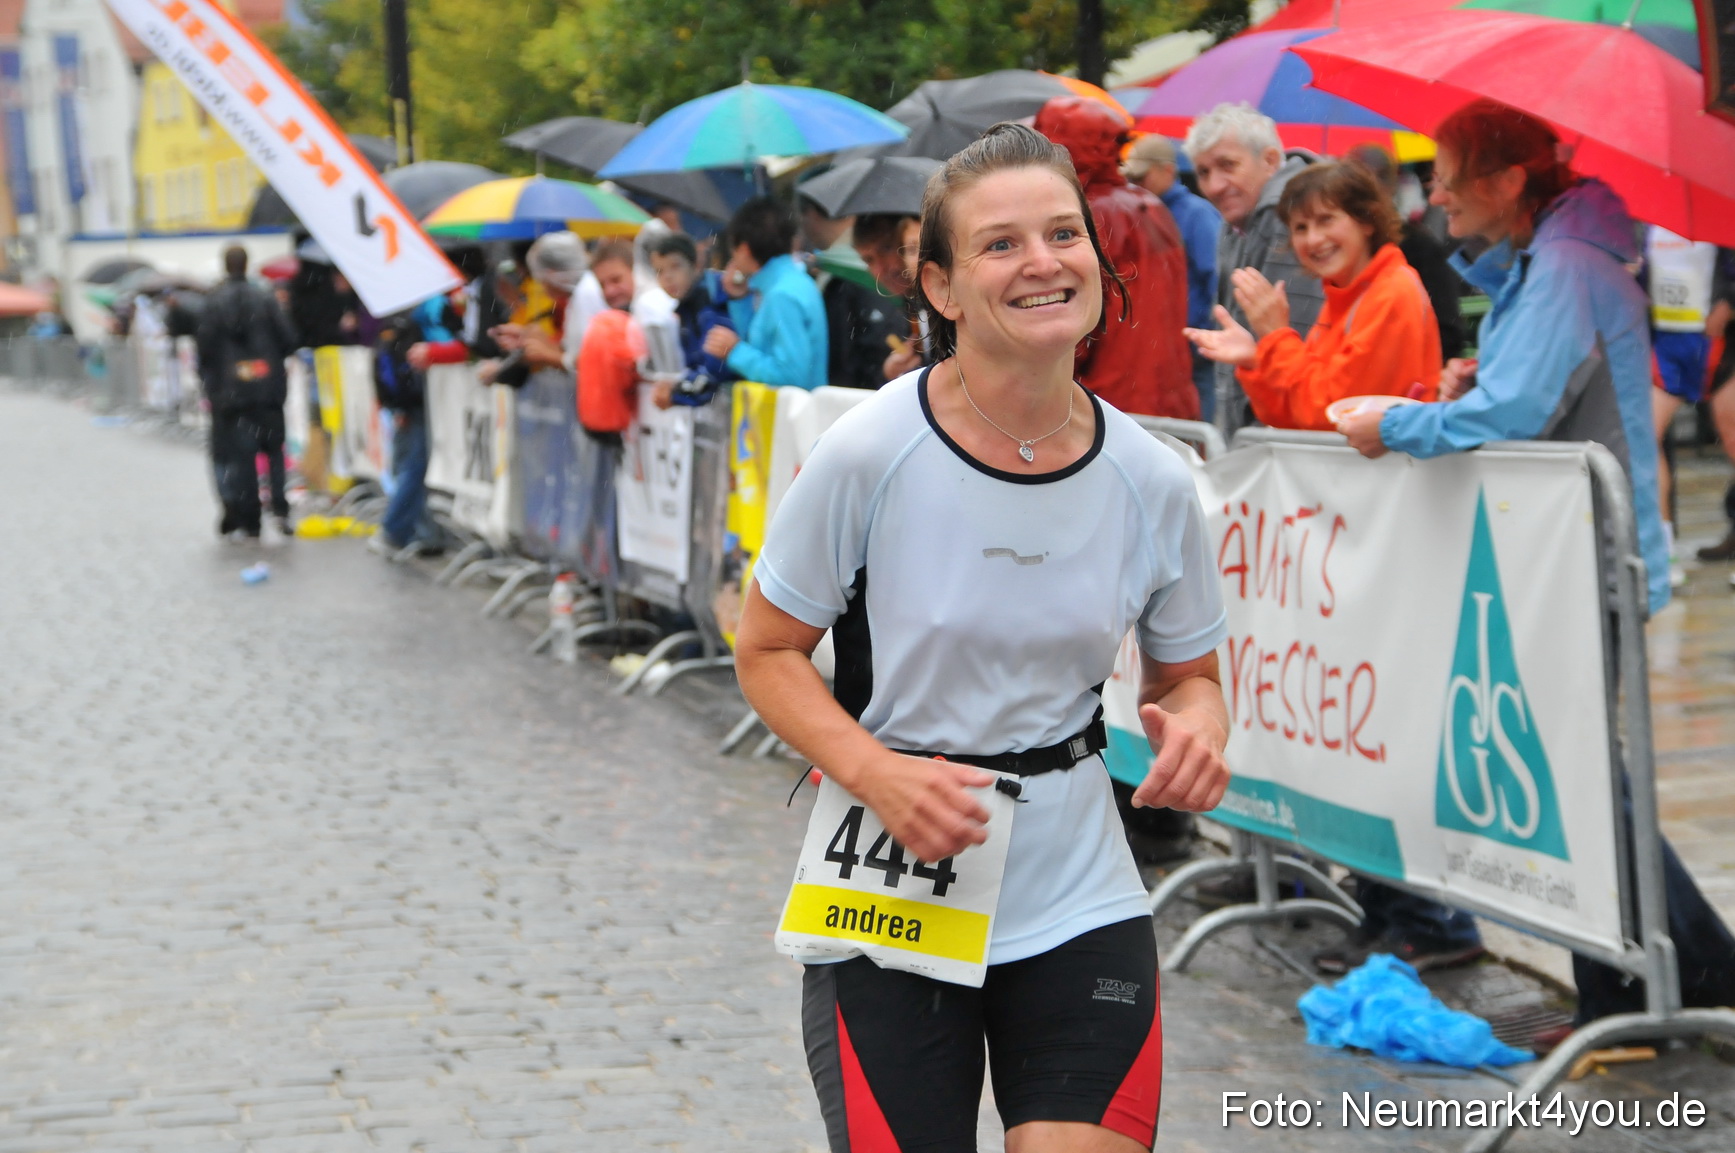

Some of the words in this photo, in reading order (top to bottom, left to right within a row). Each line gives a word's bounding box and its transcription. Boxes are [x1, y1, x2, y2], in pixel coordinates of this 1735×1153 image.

[824, 805, 957, 897] 444
[825, 904, 922, 943] andrea
[1097, 978, 1137, 994] TAO
